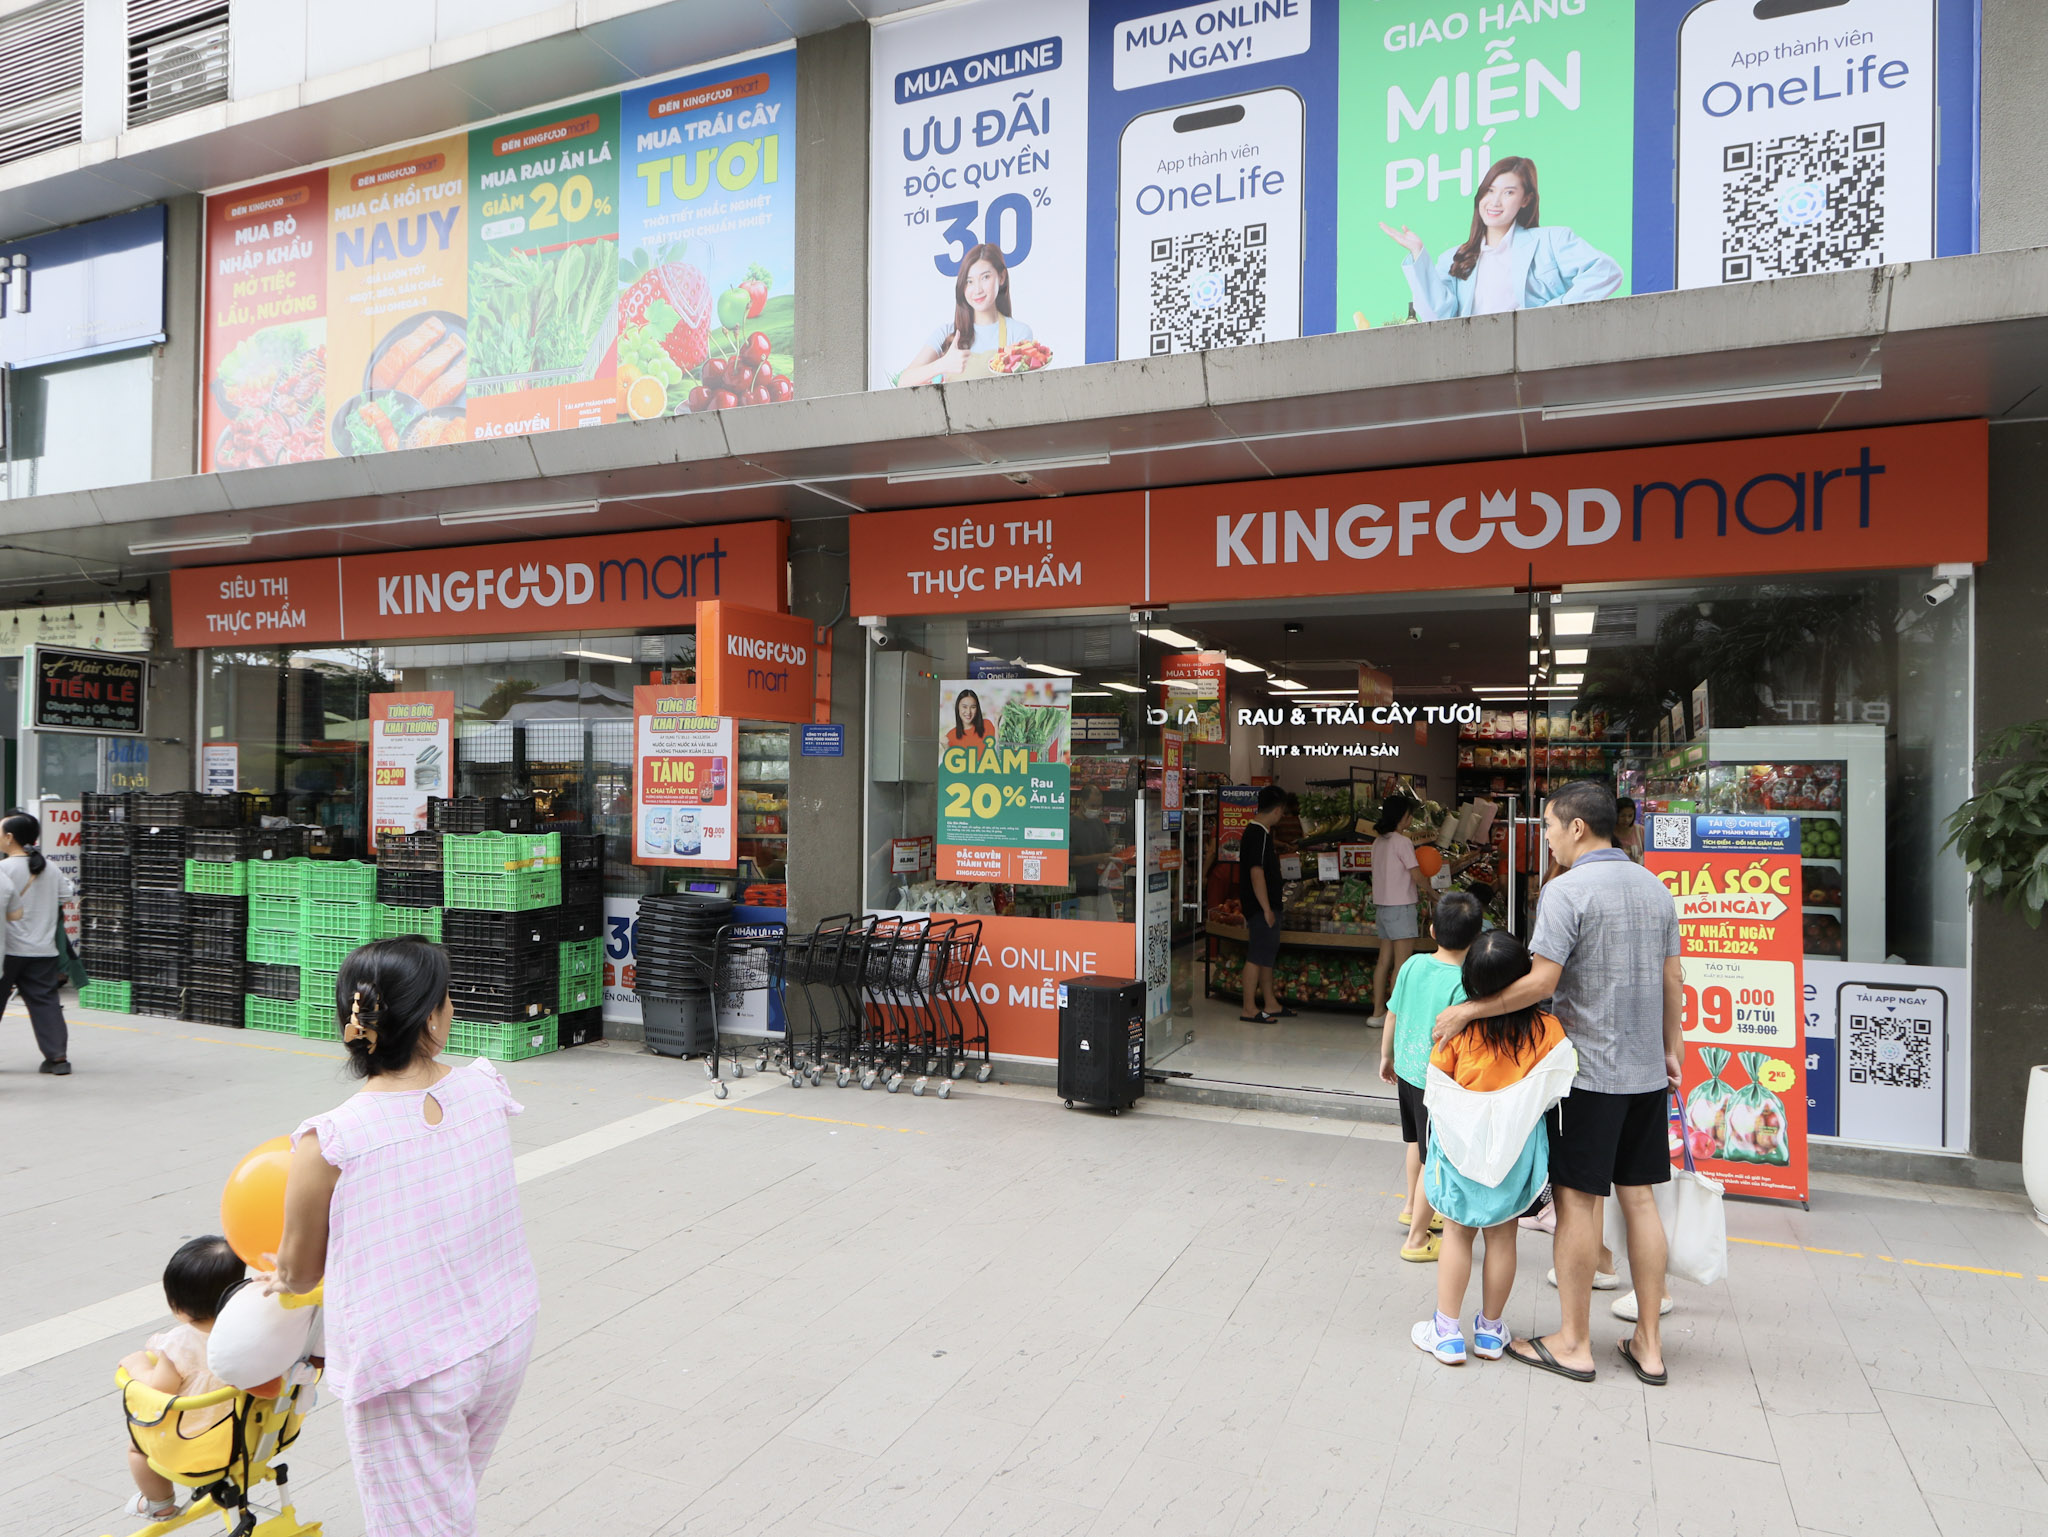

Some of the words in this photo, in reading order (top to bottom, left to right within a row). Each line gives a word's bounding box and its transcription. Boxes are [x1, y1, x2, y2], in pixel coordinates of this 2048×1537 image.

[1125, 18, 1189, 52] MUA
[1194, 0, 1299, 37] ONLINE
[1383, 12, 1469, 52] GIAO
[1167, 35, 1253, 75] NGAY!
[1730, 49, 1771, 69] App
[1774, 36, 1828, 62] thành
[1833, 28, 1874, 51] viên
[903, 66, 958, 99] MUA
[963, 41, 1055, 85] ONLINE
[1386, 37, 1582, 144] MIỄN
[1701, 53, 1910, 118] OneLife
[657, 99, 681, 115] ĐẾN
[637, 126, 682, 153] MUA
[684, 111, 734, 142] TRÁI
[737, 102, 781, 130] CÂY
[902, 115, 962, 162] ƯU
[972, 88, 1051, 148] ĐÃI
[501, 137, 521, 152] ĐẾN
[1156, 156, 1185, 175] App
[1188, 147, 1228, 169] thành
[1230, 142, 1260, 160] viên
[481, 167, 518, 190] MUA
[520, 157, 556, 181] RAU
[558, 149, 585, 172] ĂN
[588, 141, 612, 165] LÁ
[637, 133, 779, 208] TƯƠI
[903, 168, 957, 198] ĐỘC
[962, 144, 1050, 189] QUYỀN
[1384, 127, 1495, 209] PHÍ
[334, 202, 367, 222] MUA
[369, 193, 391, 214] CÁ
[393, 182, 421, 209] HỒI
[422, 179, 462, 202] TƯƠI
[482, 193, 525, 217] GIẢM
[1135, 165, 1285, 217] OneLife
[234, 223, 270, 246] MUA
[273, 213, 297, 237] BÒ
[903, 207, 931, 227] TỚI
[335, 205, 461, 272] NAUY
[219, 249, 263, 276] NHẬP
[266, 235, 313, 266] KHẨU
[233, 274, 259, 299] MỞ
[260, 269, 297, 295] TIỆC
[257, 294, 317, 321] NƯỚNG
[474, 423, 502, 440] ĐẶC
[503, 413, 550, 435] QUYỀN
[933, 518, 995, 551] SIÊU
[1003, 519, 1052, 550] THỊ
[219, 572, 259, 600] SIÊU
[260, 573, 288, 600] THỊ
[907, 564, 985, 599] THỰC
[994, 552, 1082, 591] PHẨM
[206, 611, 252, 635] THỰC
[255, 597, 306, 631] PHẨM
[726, 633, 807, 666] KINGFOOD
[69, 659, 103, 674] Hair
[102, 664, 139, 678] Salon
[747, 665, 790, 693] mart
[1166, 670, 1185, 678] MUA
[1187, 670, 1192, 678] 1
[1193, 668, 1214, 679] TẶNG
[1216, 669, 1221, 677] 1
[45, 673, 100, 700] TIẾN
[106, 680, 135, 702] LÊ
[657, 698, 683, 713] TƯNG
[1237, 708, 1285, 726] RAU
[1289, 707, 1307, 726] &
[1311, 702, 1365, 726] TRÁI
[1371, 701, 1418, 725] CÂY
[1422, 703, 1482, 725] TƯƠI
[384, 721, 404, 734] KHAI
[652, 717, 677, 731] KHAI
[678, 716, 719, 731] TRƯƠNG
[944, 737, 1028, 774] GIẢM
[1257, 744, 1289, 759] THỊT
[1290, 744, 1301, 757] &
[1302, 742, 1340, 757] THỦY
[1342, 742, 1367, 757] HẢI
[1369, 742, 1400, 757] SẢN
[650, 757, 695, 787] TẶNG
[1030, 778, 1054, 788] Rau
[944, 782, 1027, 819] 20%
[1030, 790, 1048, 803] Ăn
[1050, 792, 1065, 804] Lá
[49, 810, 81, 825] TẠO
[1709, 819, 1723, 827] TẢI
[1738, 818, 1778, 829] OneLife
[703, 826, 725, 838] 79.000
[1716, 839, 1731, 847] ĐIỂM
[1757, 840, 1773, 848] GIẢM
[1773, 840, 1784, 848] GIÁ
[1722, 828, 1744, 836] THÀNH
[1744, 828, 1759, 836] VIÊN
[1759, 829, 1777, 837] NGAY
[956, 848, 973, 860] ĐẶC
[974, 849, 1001, 860] QUYỀN
[956, 858, 982, 868] THÀNH
[983, 859, 1001, 868] VIÊN
[1657, 862, 1718, 897] GIÁ
[1724, 858, 1791, 895] SỐC
[1683, 893, 1717, 915] MỖI
[1720, 896, 1772, 915] NGÀY
[733, 926, 757, 938] NHẬN
[1699, 921, 1736, 939] NHẤT
[1739, 924, 1776, 941] NGÀY
[1000, 946, 1097, 974] ONLINE
[1686, 938, 1760, 955] 30.11.2024
[1705, 962, 1724, 972] TÁO
[1726, 963, 1740, 972] TÚI
[1008, 978, 1060, 1010] MIỄ
[1856, 993, 1872, 1002] TẢI
[1875, 995, 1897, 1004] APP
[1898, 997, 1928, 1007] NGAY
[1736, 1007, 1775, 1023] Đ/TÚI
[1736, 1023, 1780, 1035] 139.000
[1761, 1182, 1797, 1191] Kingfoodmart
